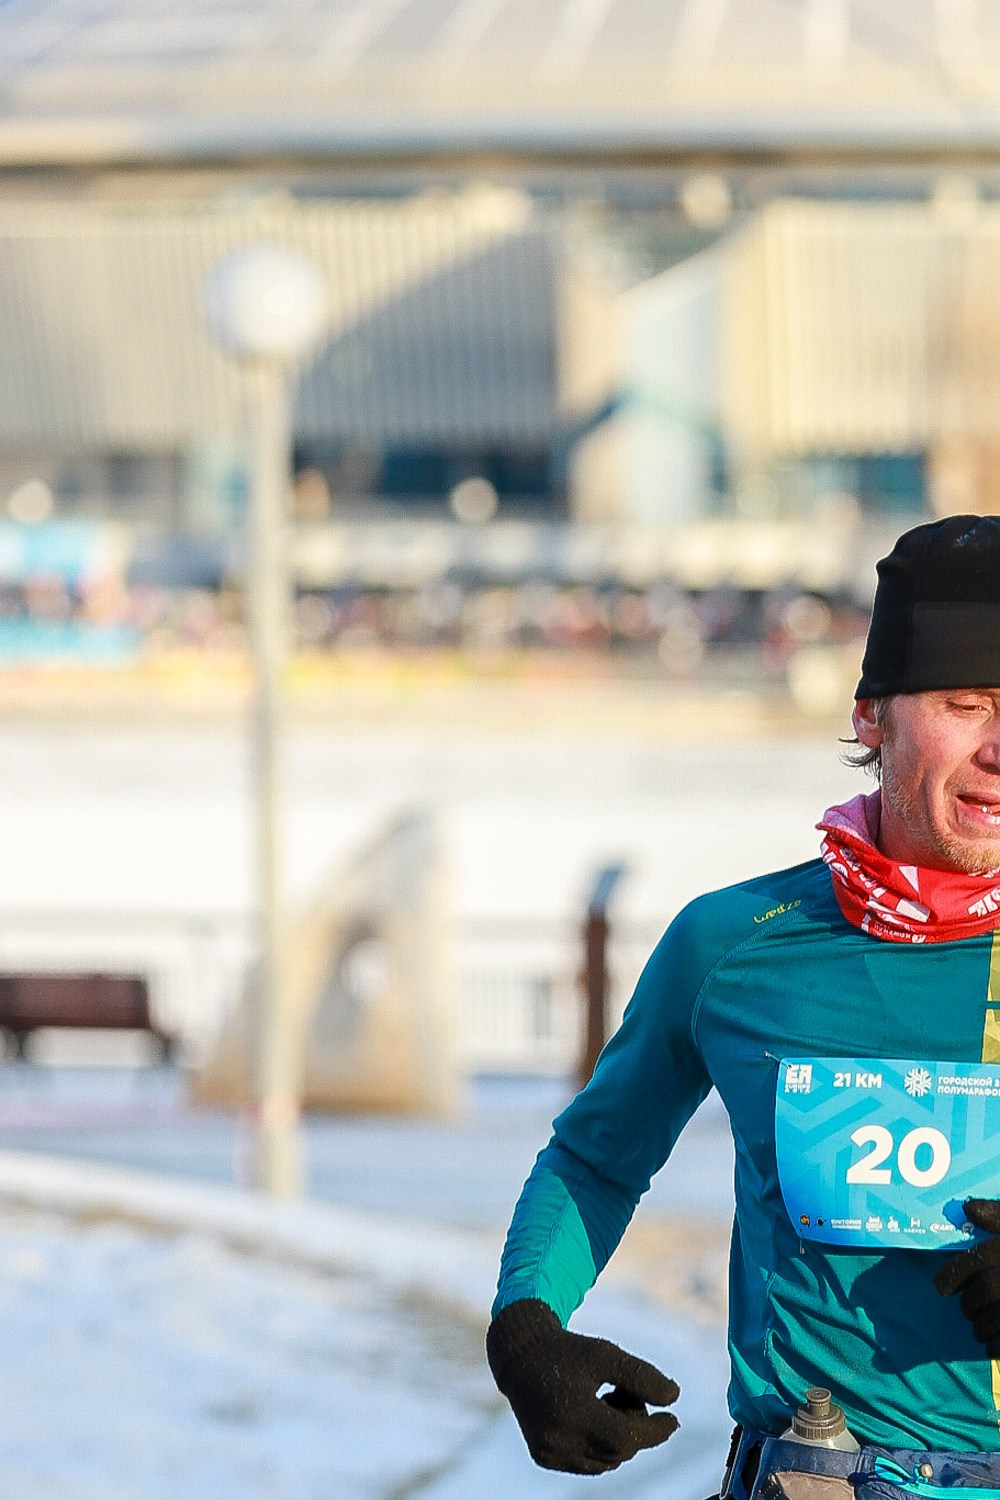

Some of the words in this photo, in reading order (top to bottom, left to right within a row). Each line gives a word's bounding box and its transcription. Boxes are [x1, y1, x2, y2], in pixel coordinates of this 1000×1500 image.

[833, 1072, 852, 1088] 21
[938, 1076, 992, 1087] ГОРОДСКОЙ
[846, 1124, 952, 1188] 20
